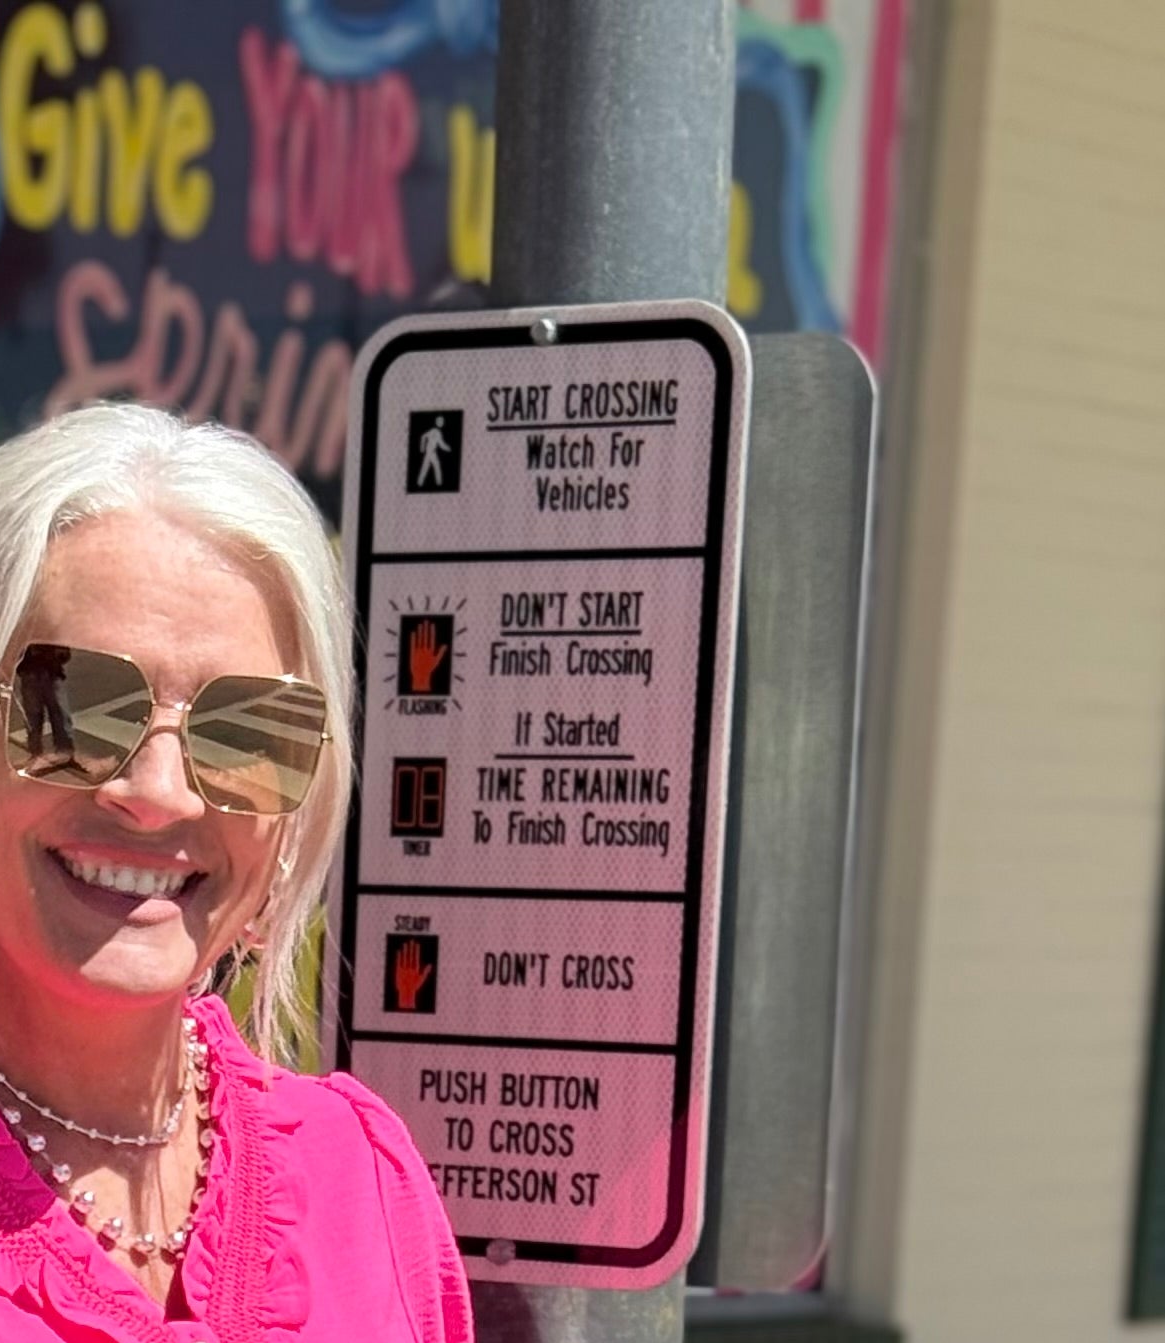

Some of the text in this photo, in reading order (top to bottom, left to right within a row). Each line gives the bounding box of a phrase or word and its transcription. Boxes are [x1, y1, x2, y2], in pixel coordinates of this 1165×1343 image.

[239, 25, 416, 302] YOUR
[42, 258, 355, 480] Sprin
[488, 379, 679, 422] START CROSSING
[527, 431, 644, 469] Watch For
[537, 475, 630, 512] Vehicles
[501, 591, 643, 627] DON'T START
[489, 641, 653, 687] Finish Crossing
[516, 712, 620, 746] If Started
[477, 767, 670, 804] TIME REMAINING
[472, 810, 670, 858] To Finish Crossing
[484, 951, 635, 990] DON'T CROSS
[419, 1069, 600, 1111] PUSH BUTTON
[444, 1117, 575, 1157] TO CROSS
[426, 1163, 600, 1206] EFFERSON ST
